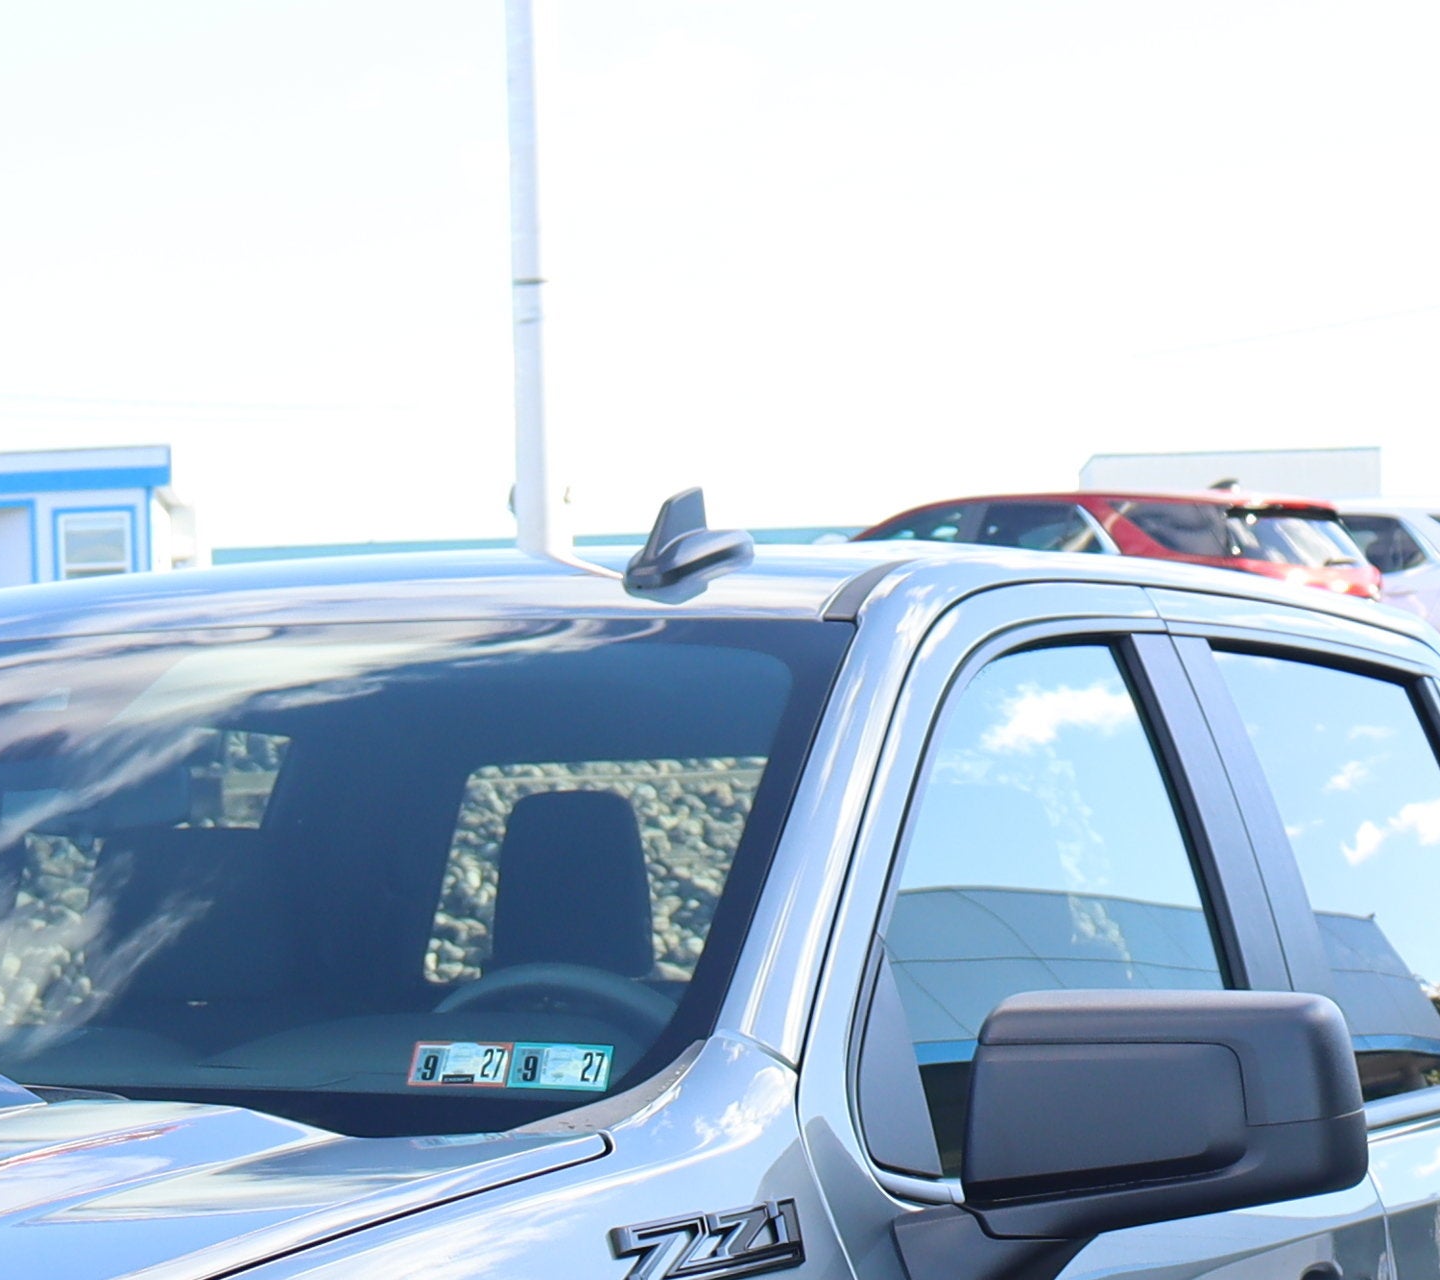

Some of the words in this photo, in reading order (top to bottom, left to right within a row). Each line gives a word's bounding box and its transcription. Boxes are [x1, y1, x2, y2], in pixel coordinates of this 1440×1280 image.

[421, 1054, 439, 1081] 9
[480, 1048, 506, 1080] 27
[522, 1055, 539, 1082] 9
[580, 1052, 605, 1082] 27
